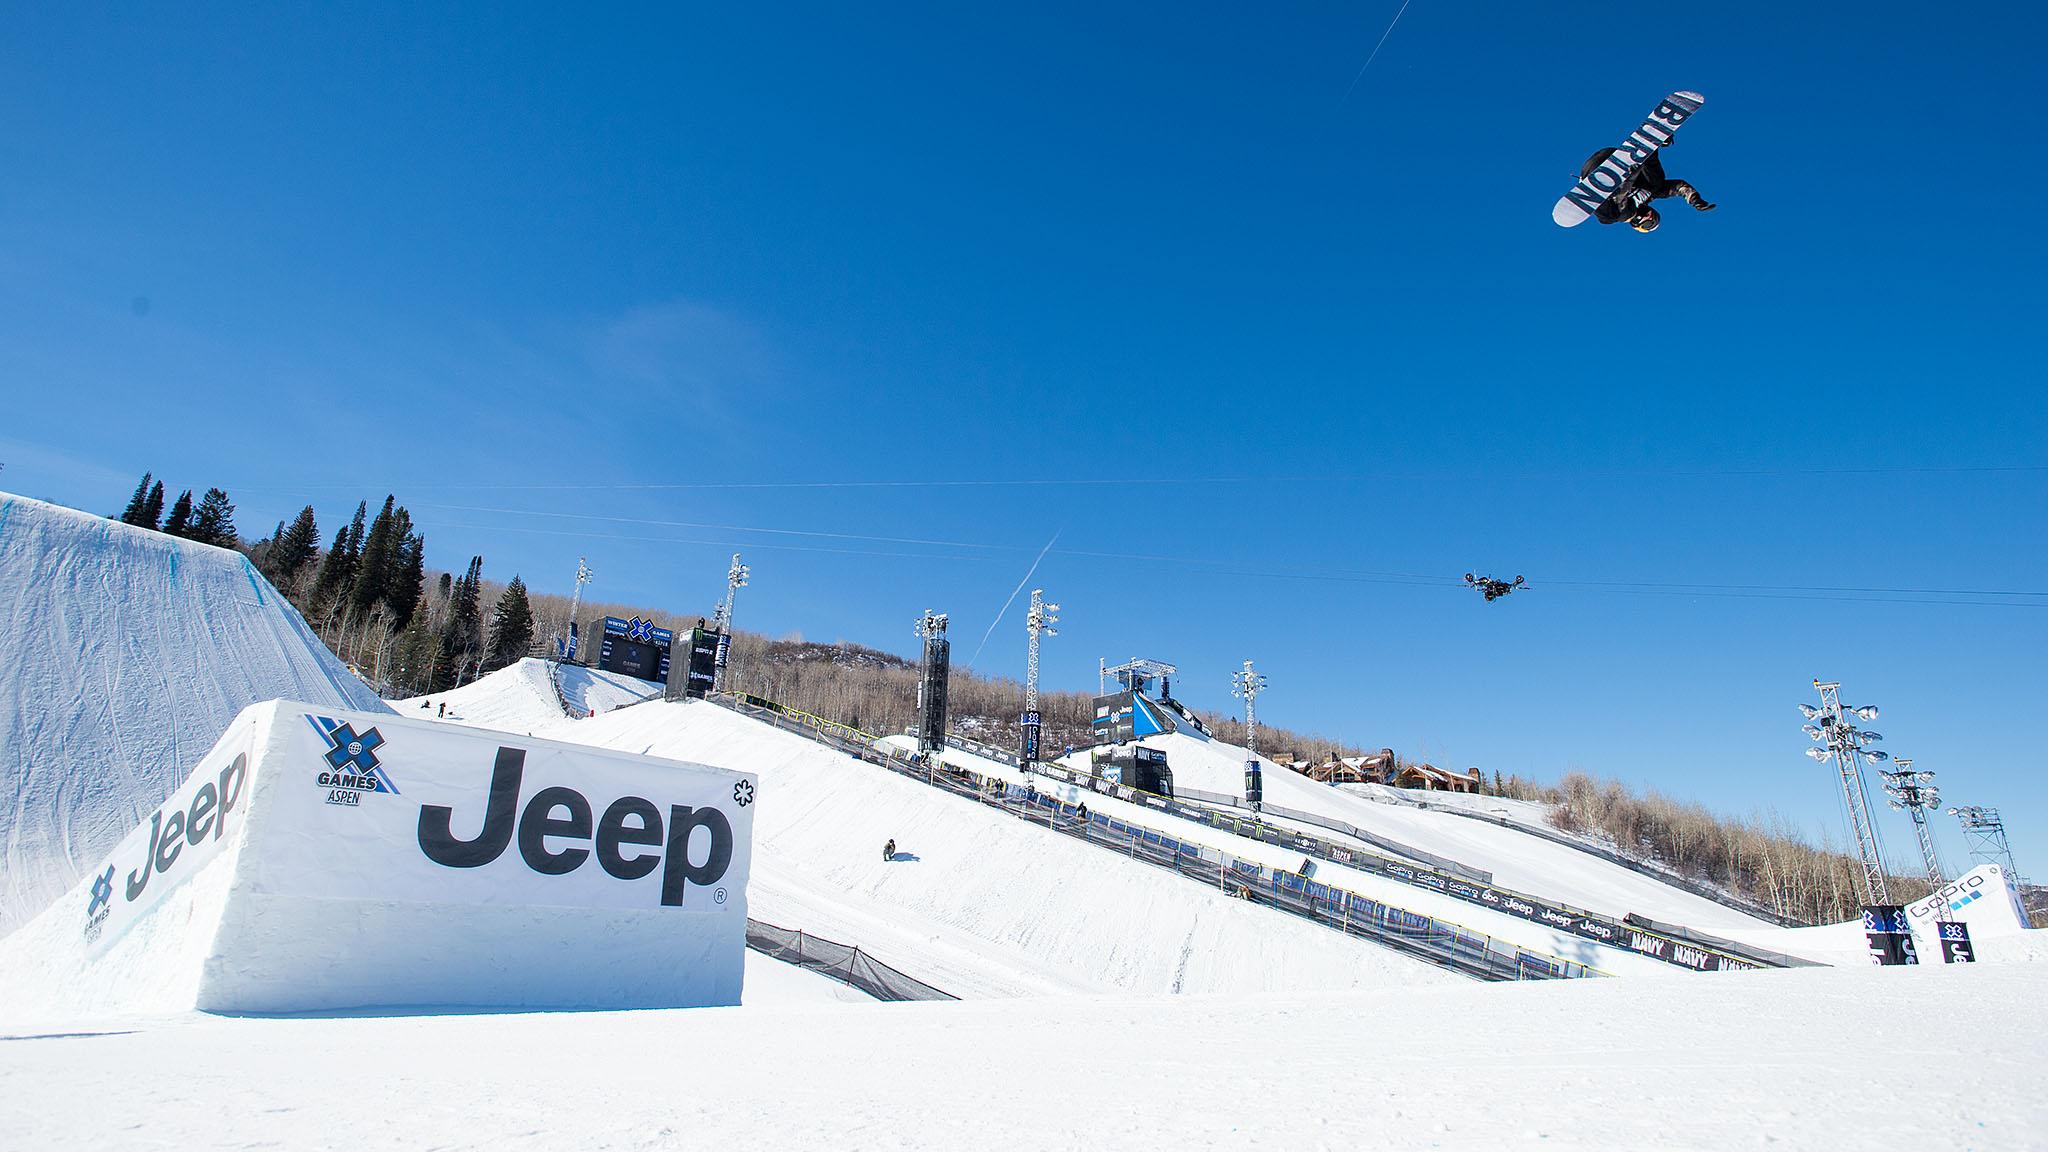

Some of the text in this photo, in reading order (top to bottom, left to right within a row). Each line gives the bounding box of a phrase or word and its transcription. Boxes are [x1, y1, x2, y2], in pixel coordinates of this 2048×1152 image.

[1565, 99, 1693, 216] BURTON
[965, 742, 978, 752] Jeep
[980, 747, 993, 757] Jeep
[995, 751, 1009, 761] Jeep
[317, 772, 378, 791] GAMES
[327, 788, 361, 805] ASPEN
[125, 751, 247, 903] Jeep
[417, 745, 734, 907] Jeep
[1386, 863, 1414, 876] GoPro
[1417, 872, 1446, 885] GoPro
[1448, 881, 1479, 895] GoPro
[1909, 875, 1984, 918] GoPro
[1504, 897, 1534, 916] Jeep
[1541, 909, 1572, 927] Jeep
[1580, 919, 1611, 938] Jeep
[1631, 931, 1665, 956] NAVY
[1673, 944, 1708, 969] NAVY
